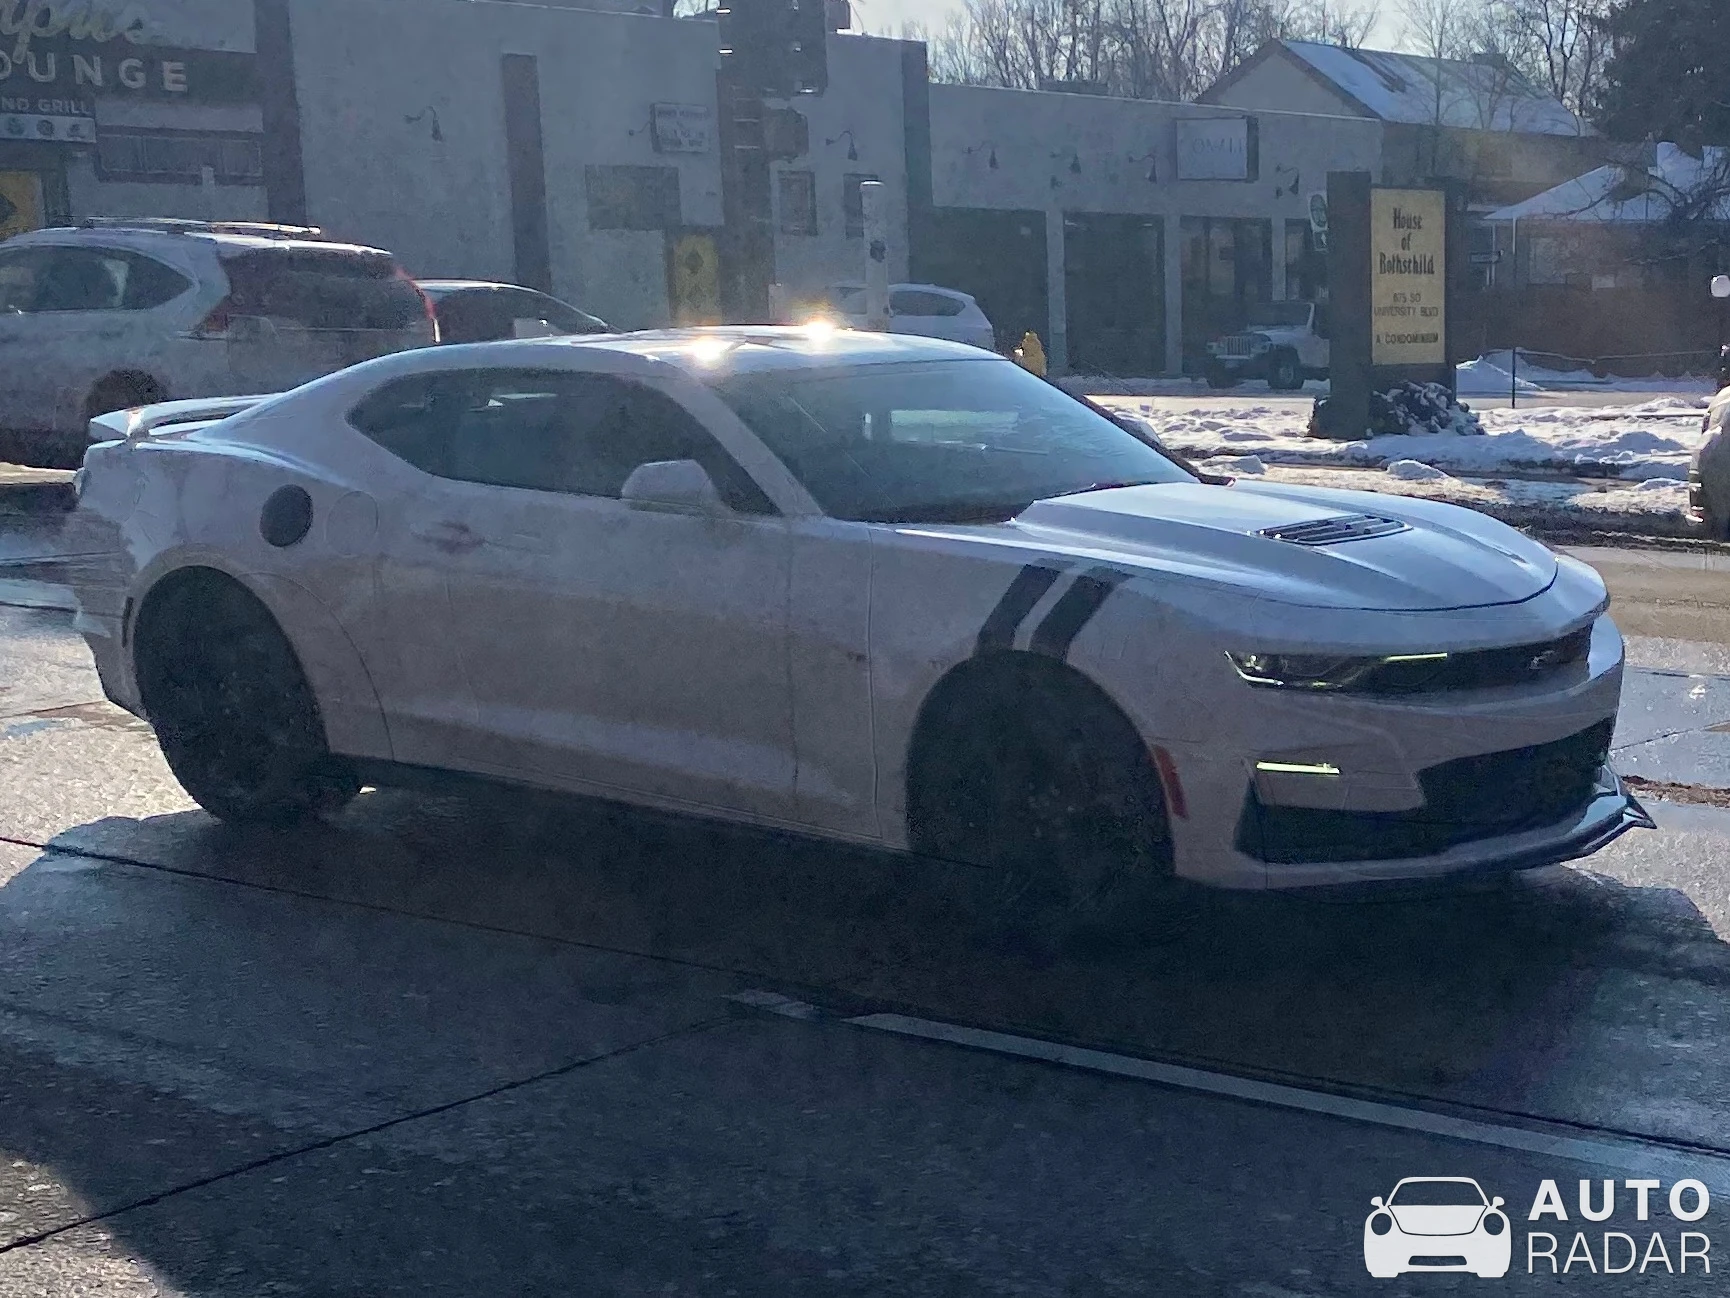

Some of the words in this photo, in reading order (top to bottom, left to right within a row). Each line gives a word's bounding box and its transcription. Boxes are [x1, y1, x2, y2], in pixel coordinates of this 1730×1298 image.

[38, 98, 92, 114] GRILL
[1393, 207, 1422, 229] House
[1401, 232, 1411, 250] of
[1380, 252, 1435, 274] Rothschild
[1374, 307, 1416, 316] UNIVERSITY
[1421, 307, 1438, 316] BLVD
[1376, 334, 1381, 344] A
[1385, 333, 1438, 344] CONDOMINIUM
